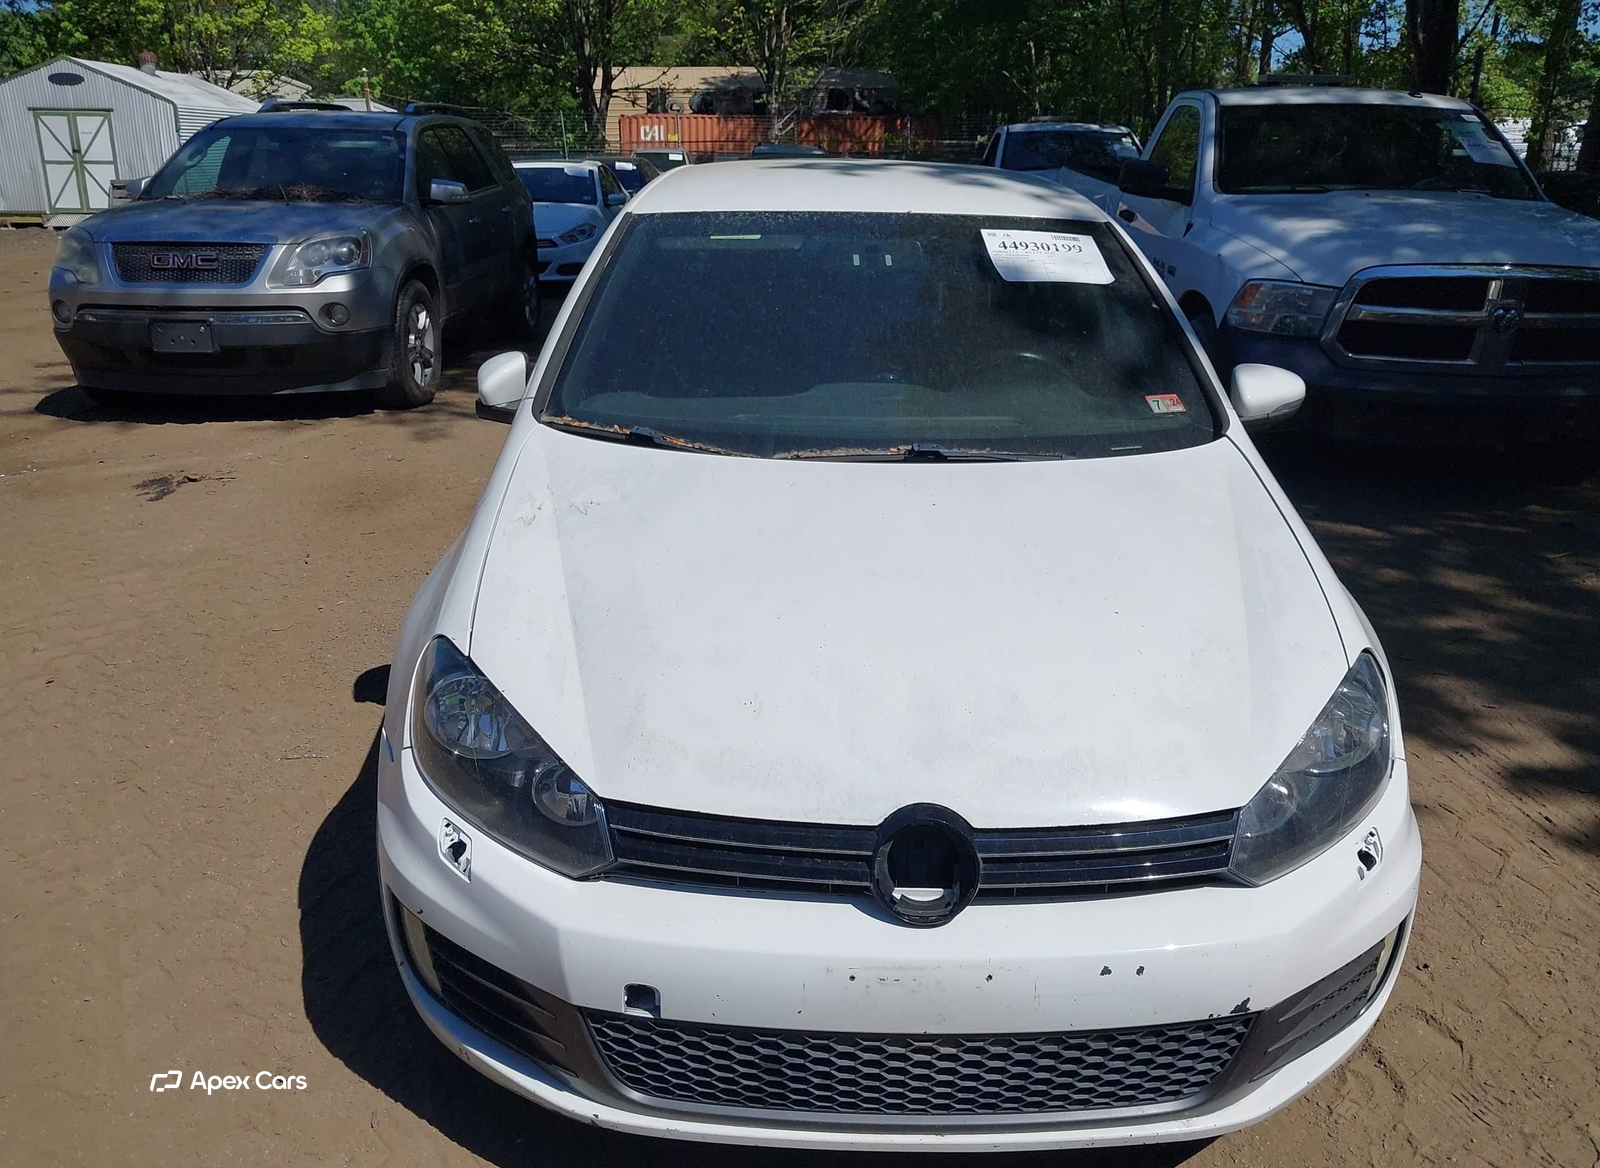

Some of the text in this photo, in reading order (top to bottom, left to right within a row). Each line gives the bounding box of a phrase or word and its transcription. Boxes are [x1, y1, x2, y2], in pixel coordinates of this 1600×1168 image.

[640, 125, 665, 141] CAI
[997, 239, 1083, 254] 44930199
[150, 252, 218, 269] GMC
[1152, 399, 1161, 411] 7
